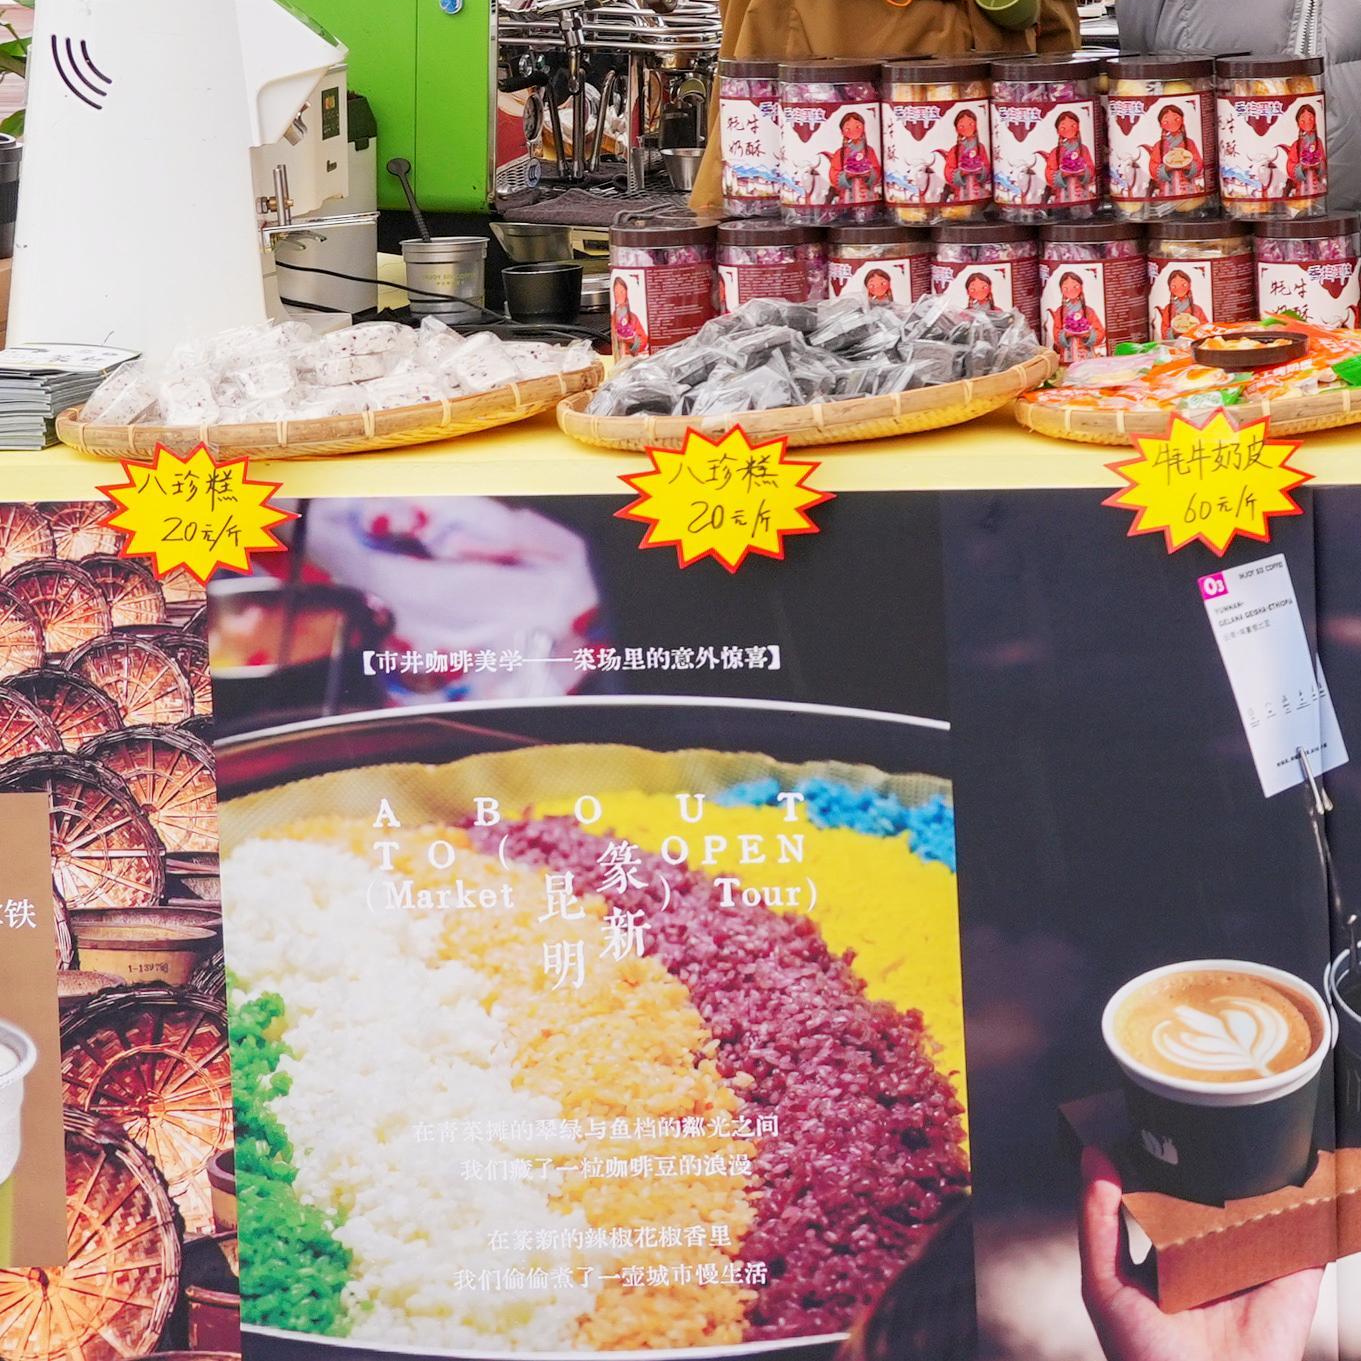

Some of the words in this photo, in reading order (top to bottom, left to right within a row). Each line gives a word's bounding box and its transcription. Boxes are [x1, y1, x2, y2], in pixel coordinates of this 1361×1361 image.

[667, 450, 780, 490] 八珍糕
[1151, 434, 1273, 486] 牦牛奶皮
[139, 472, 241, 506] 八珍糕
[660, 834, 805, 866] OPEN
[0, 898, 37, 929] 铁
